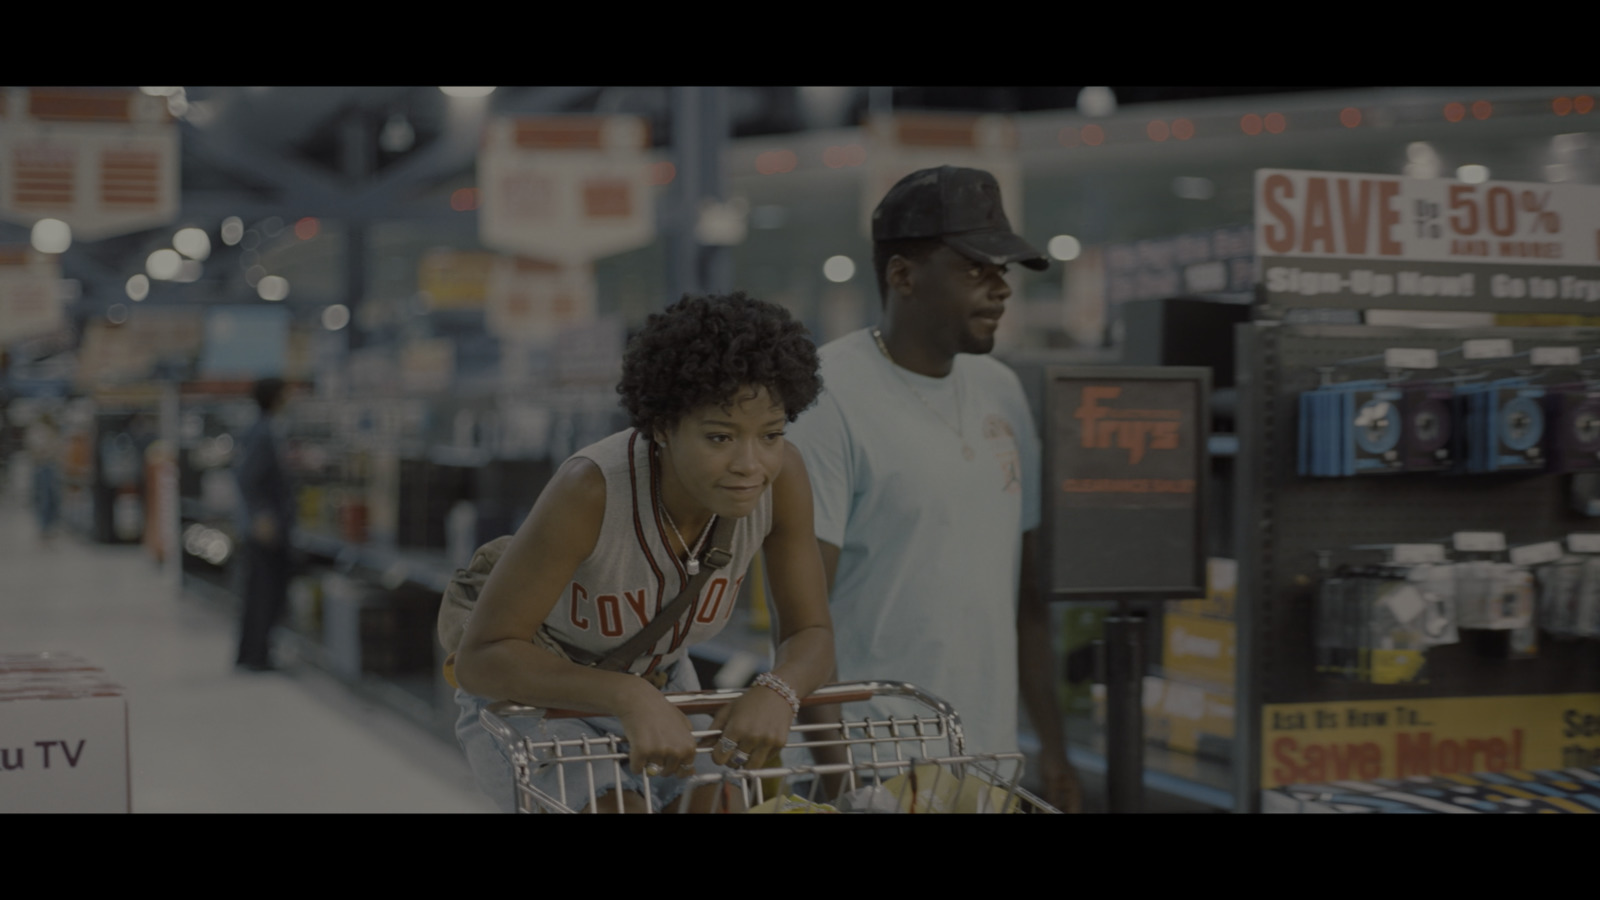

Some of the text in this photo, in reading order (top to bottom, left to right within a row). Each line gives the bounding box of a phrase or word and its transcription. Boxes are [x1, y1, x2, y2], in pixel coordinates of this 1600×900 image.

[1263, 174, 1404, 256] SAVE
[1413, 198, 1440, 219] Up
[1448, 185, 1562, 237] 50%
[1266, 266, 1395, 299] Sign-Up
[1397, 270, 1476, 297] Now!
[34, 739, 86, 769] TV
[1271, 728, 1526, 785] Save More!
